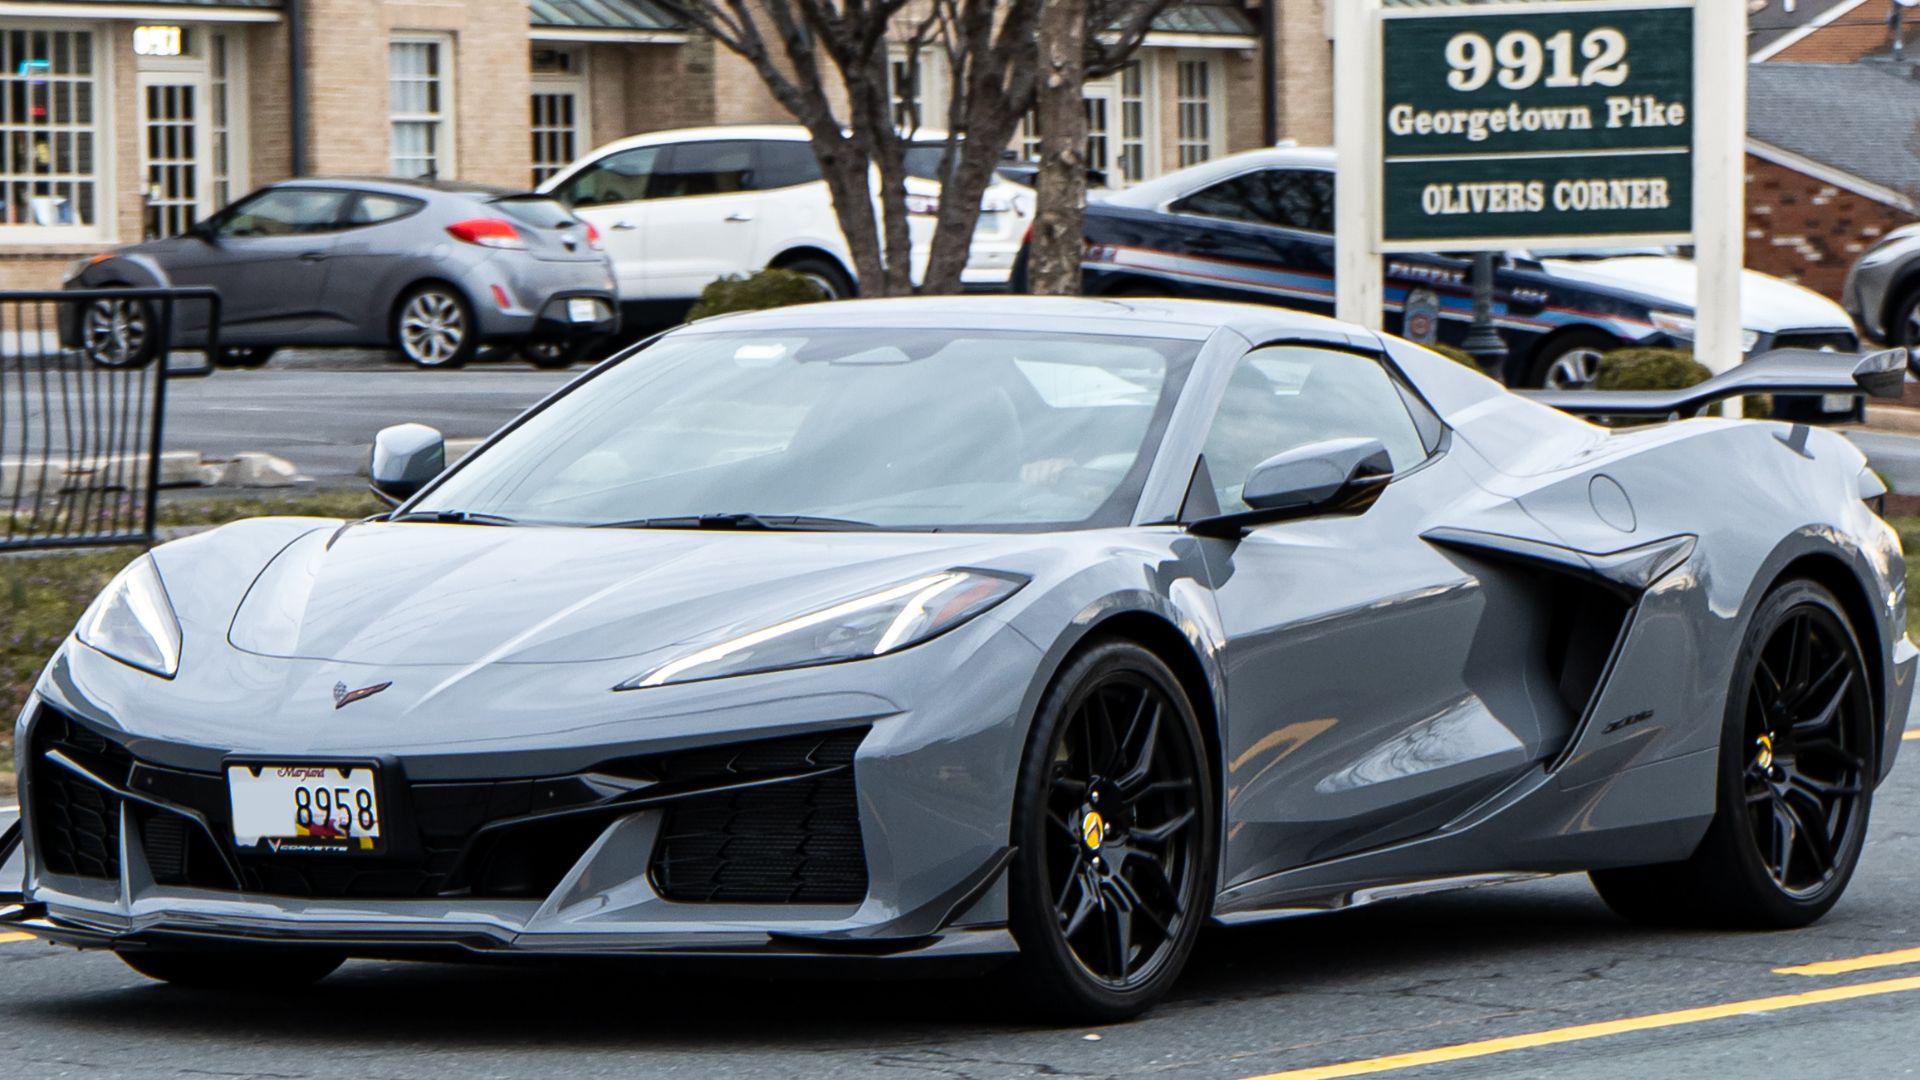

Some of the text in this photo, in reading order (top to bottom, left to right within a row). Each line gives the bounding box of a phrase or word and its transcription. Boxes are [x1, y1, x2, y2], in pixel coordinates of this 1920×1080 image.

[1445, 27, 1629, 91] 9912
[1388, 96, 1686, 141] Georgetown Pike
[1422, 178, 1669, 215] OLIVERS CORNER
[277, 767, 325, 781] Maryland
[295, 786, 374, 831] 8958
